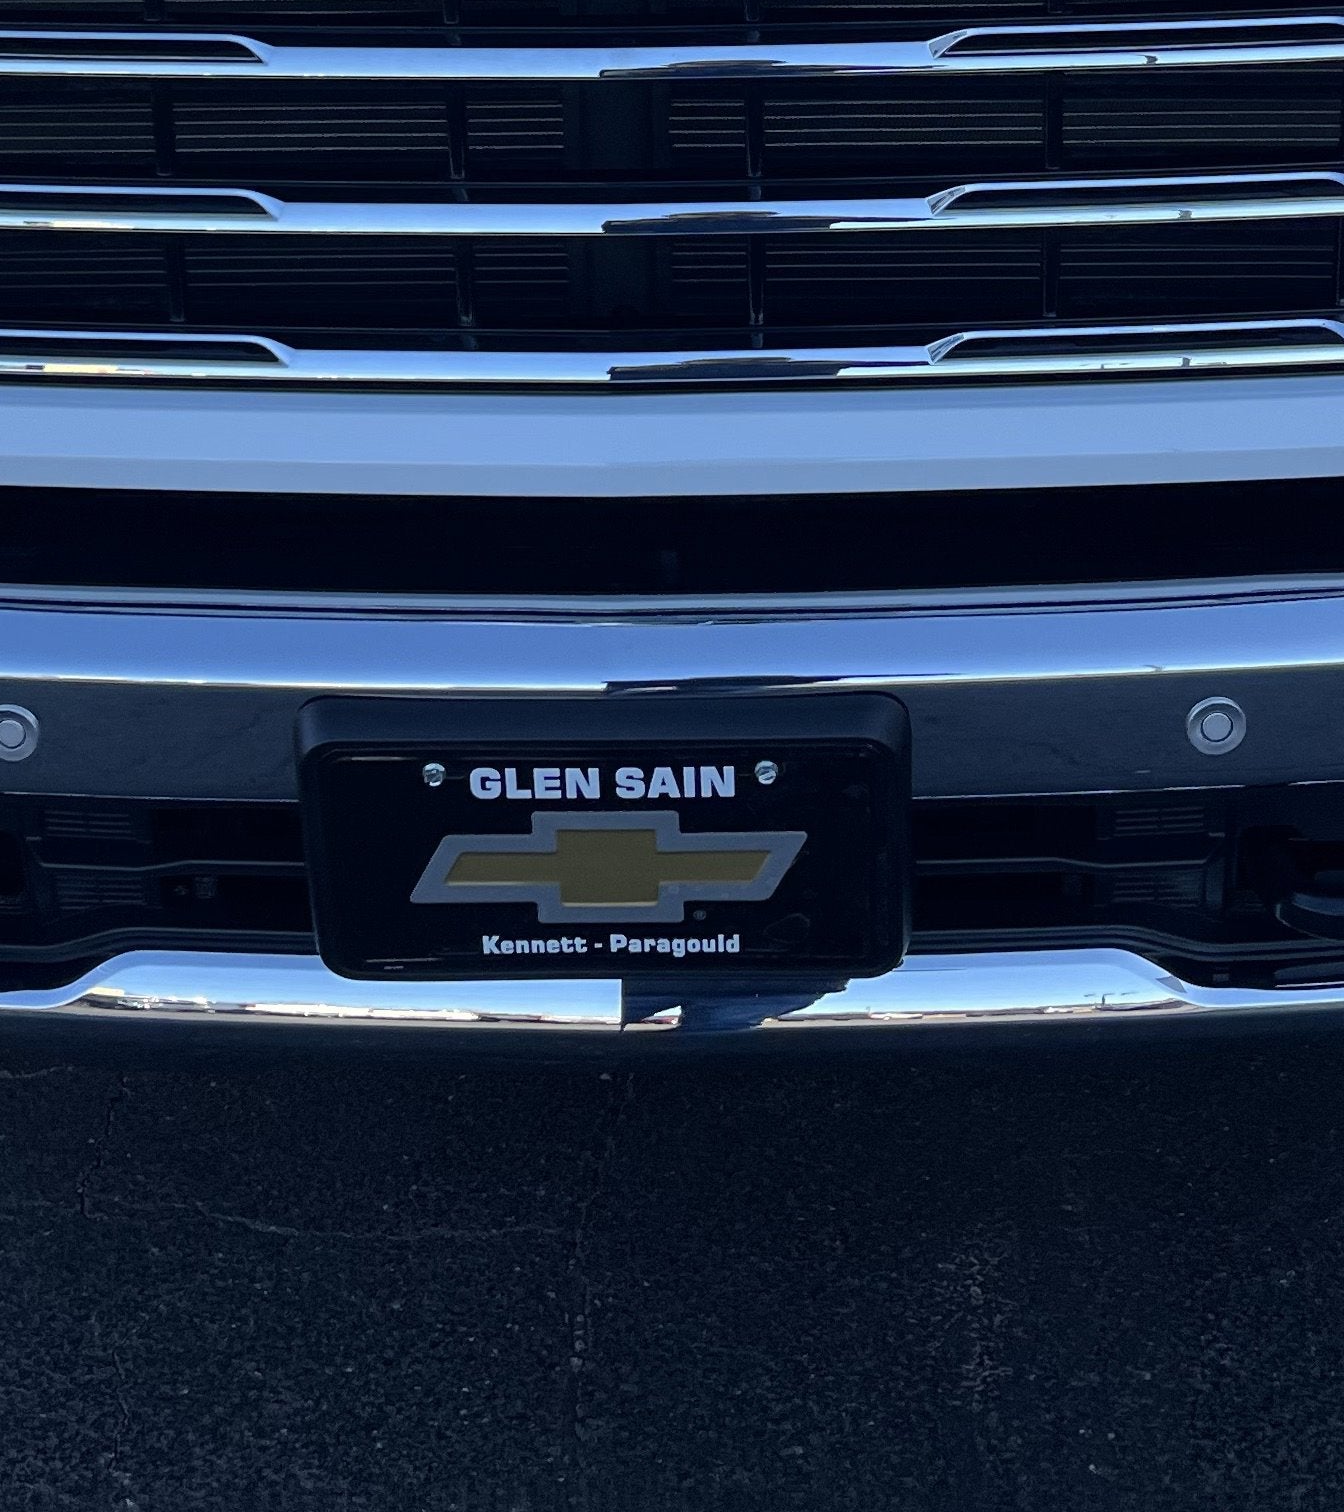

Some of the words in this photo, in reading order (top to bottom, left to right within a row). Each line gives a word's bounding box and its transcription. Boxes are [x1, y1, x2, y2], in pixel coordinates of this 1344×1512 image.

[469, 767, 601, 799] GLEN
[615, 766, 736, 799] SAIN
[482, 934, 588, 954] Kennett
[610, 933, 740, 957] Paragould
